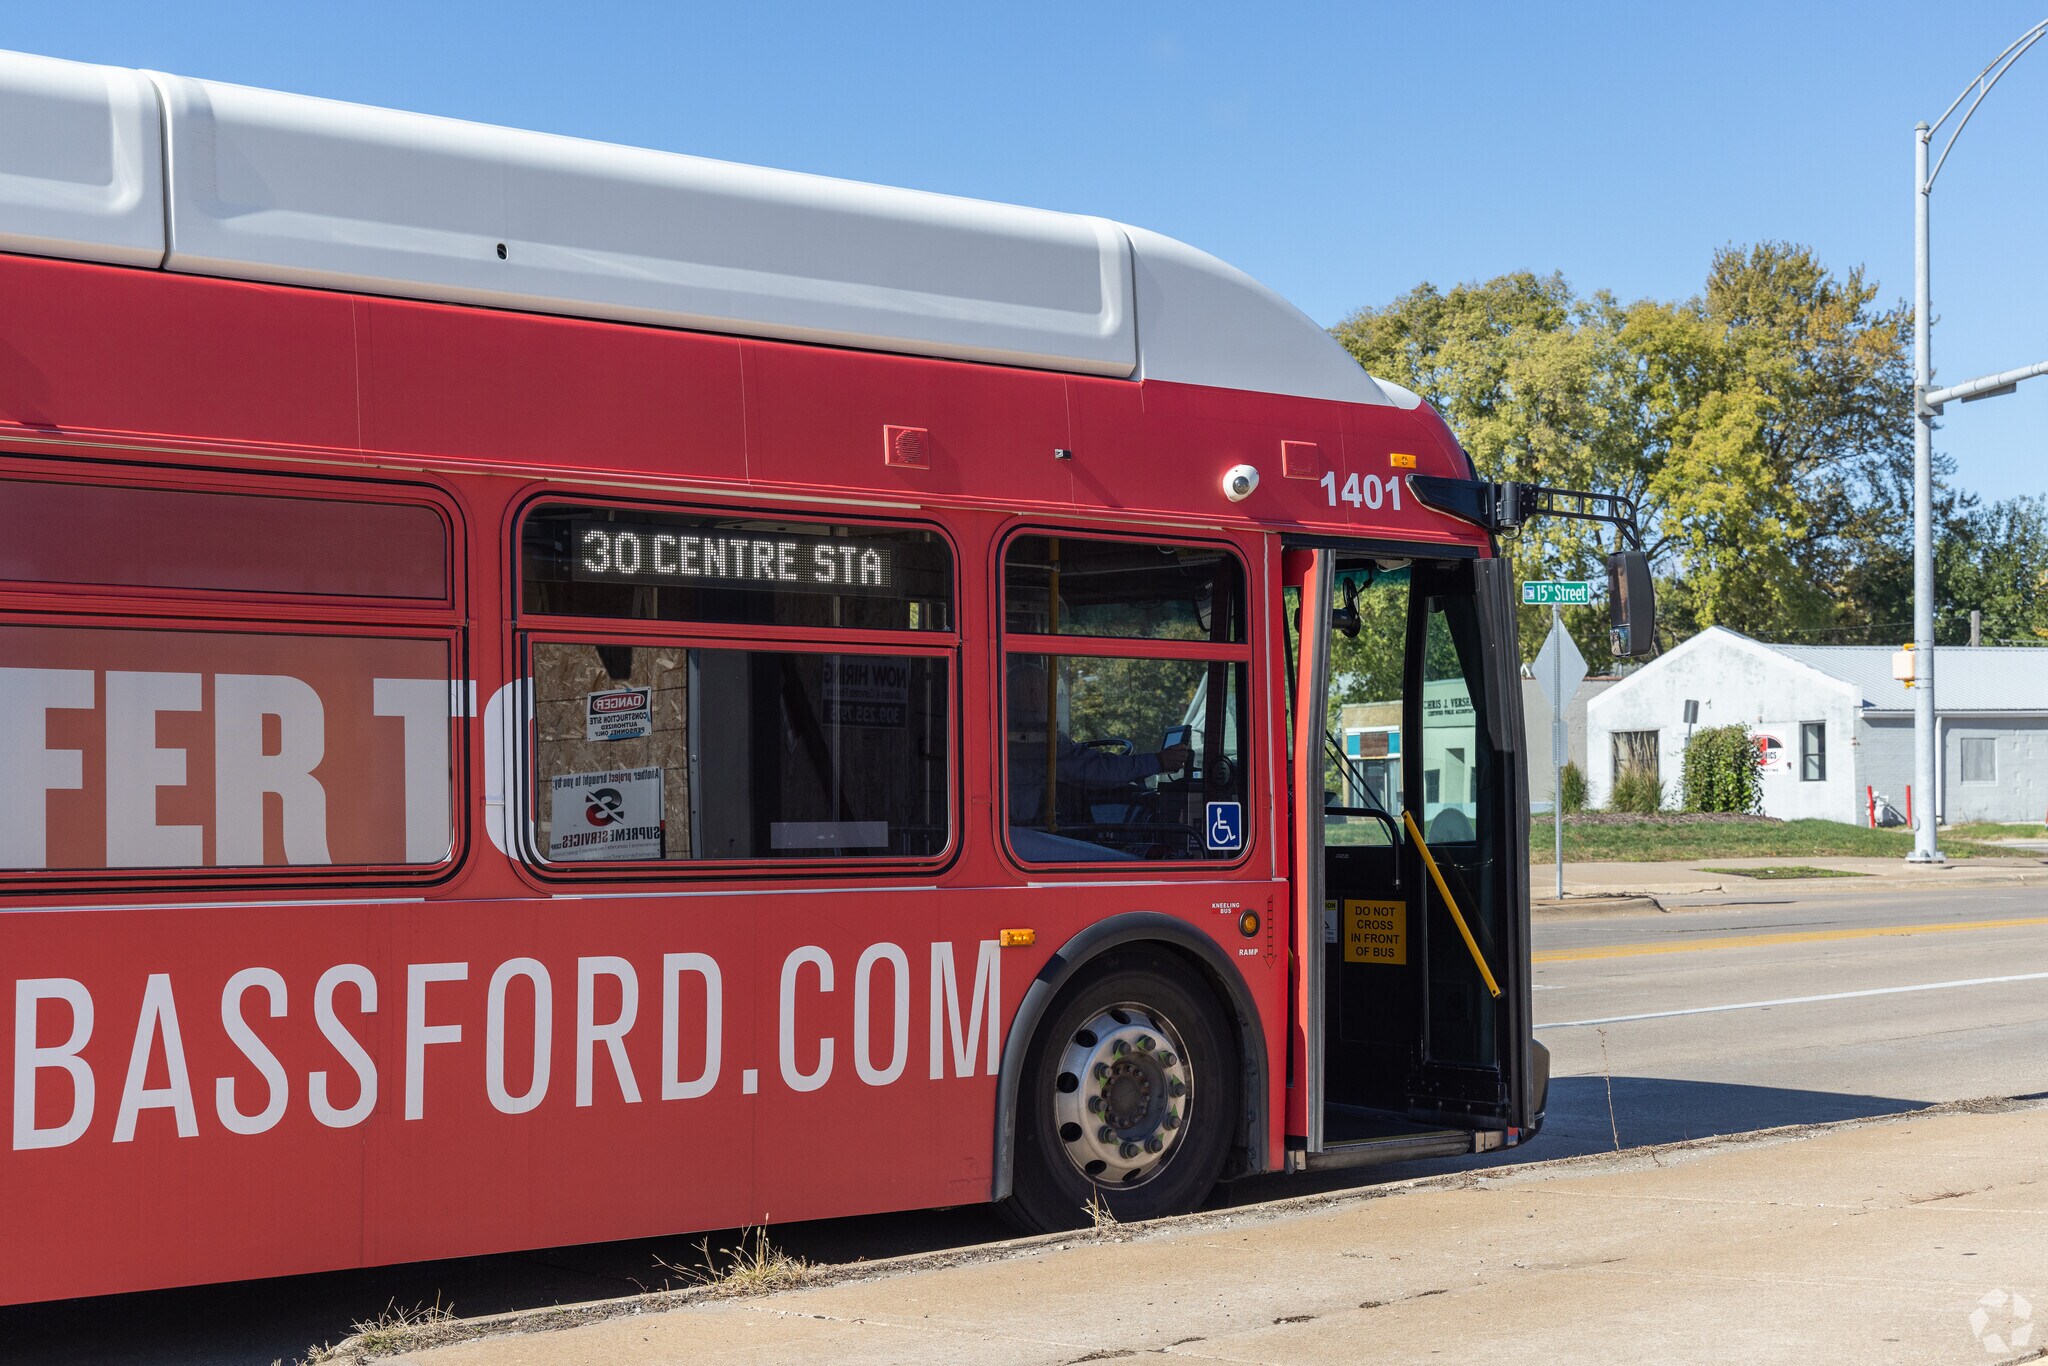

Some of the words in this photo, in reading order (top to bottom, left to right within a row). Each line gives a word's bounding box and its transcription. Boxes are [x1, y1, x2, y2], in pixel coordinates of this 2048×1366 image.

[1320, 471, 1401, 511] 1401
[584, 530, 641, 574] 30
[653, 535, 797, 581] CENTRE
[814, 544, 882, 585] STA
[1554, 584, 1587, 602] Street
[1355, 906, 1371, 916] DO
[1373, 907, 1396, 917] NOT
[1356, 919, 1394, 930] CROSS
[1350, 933, 1361, 943] IN
[1364, 934, 1400, 944] FRONT
[1238, 948, 1259, 956] RAMP
[1355, 946, 1370, 956] OF
[1373, 947, 1395, 957] BUS
[13, 940, 1001, 1151] BASSFORD.COM
